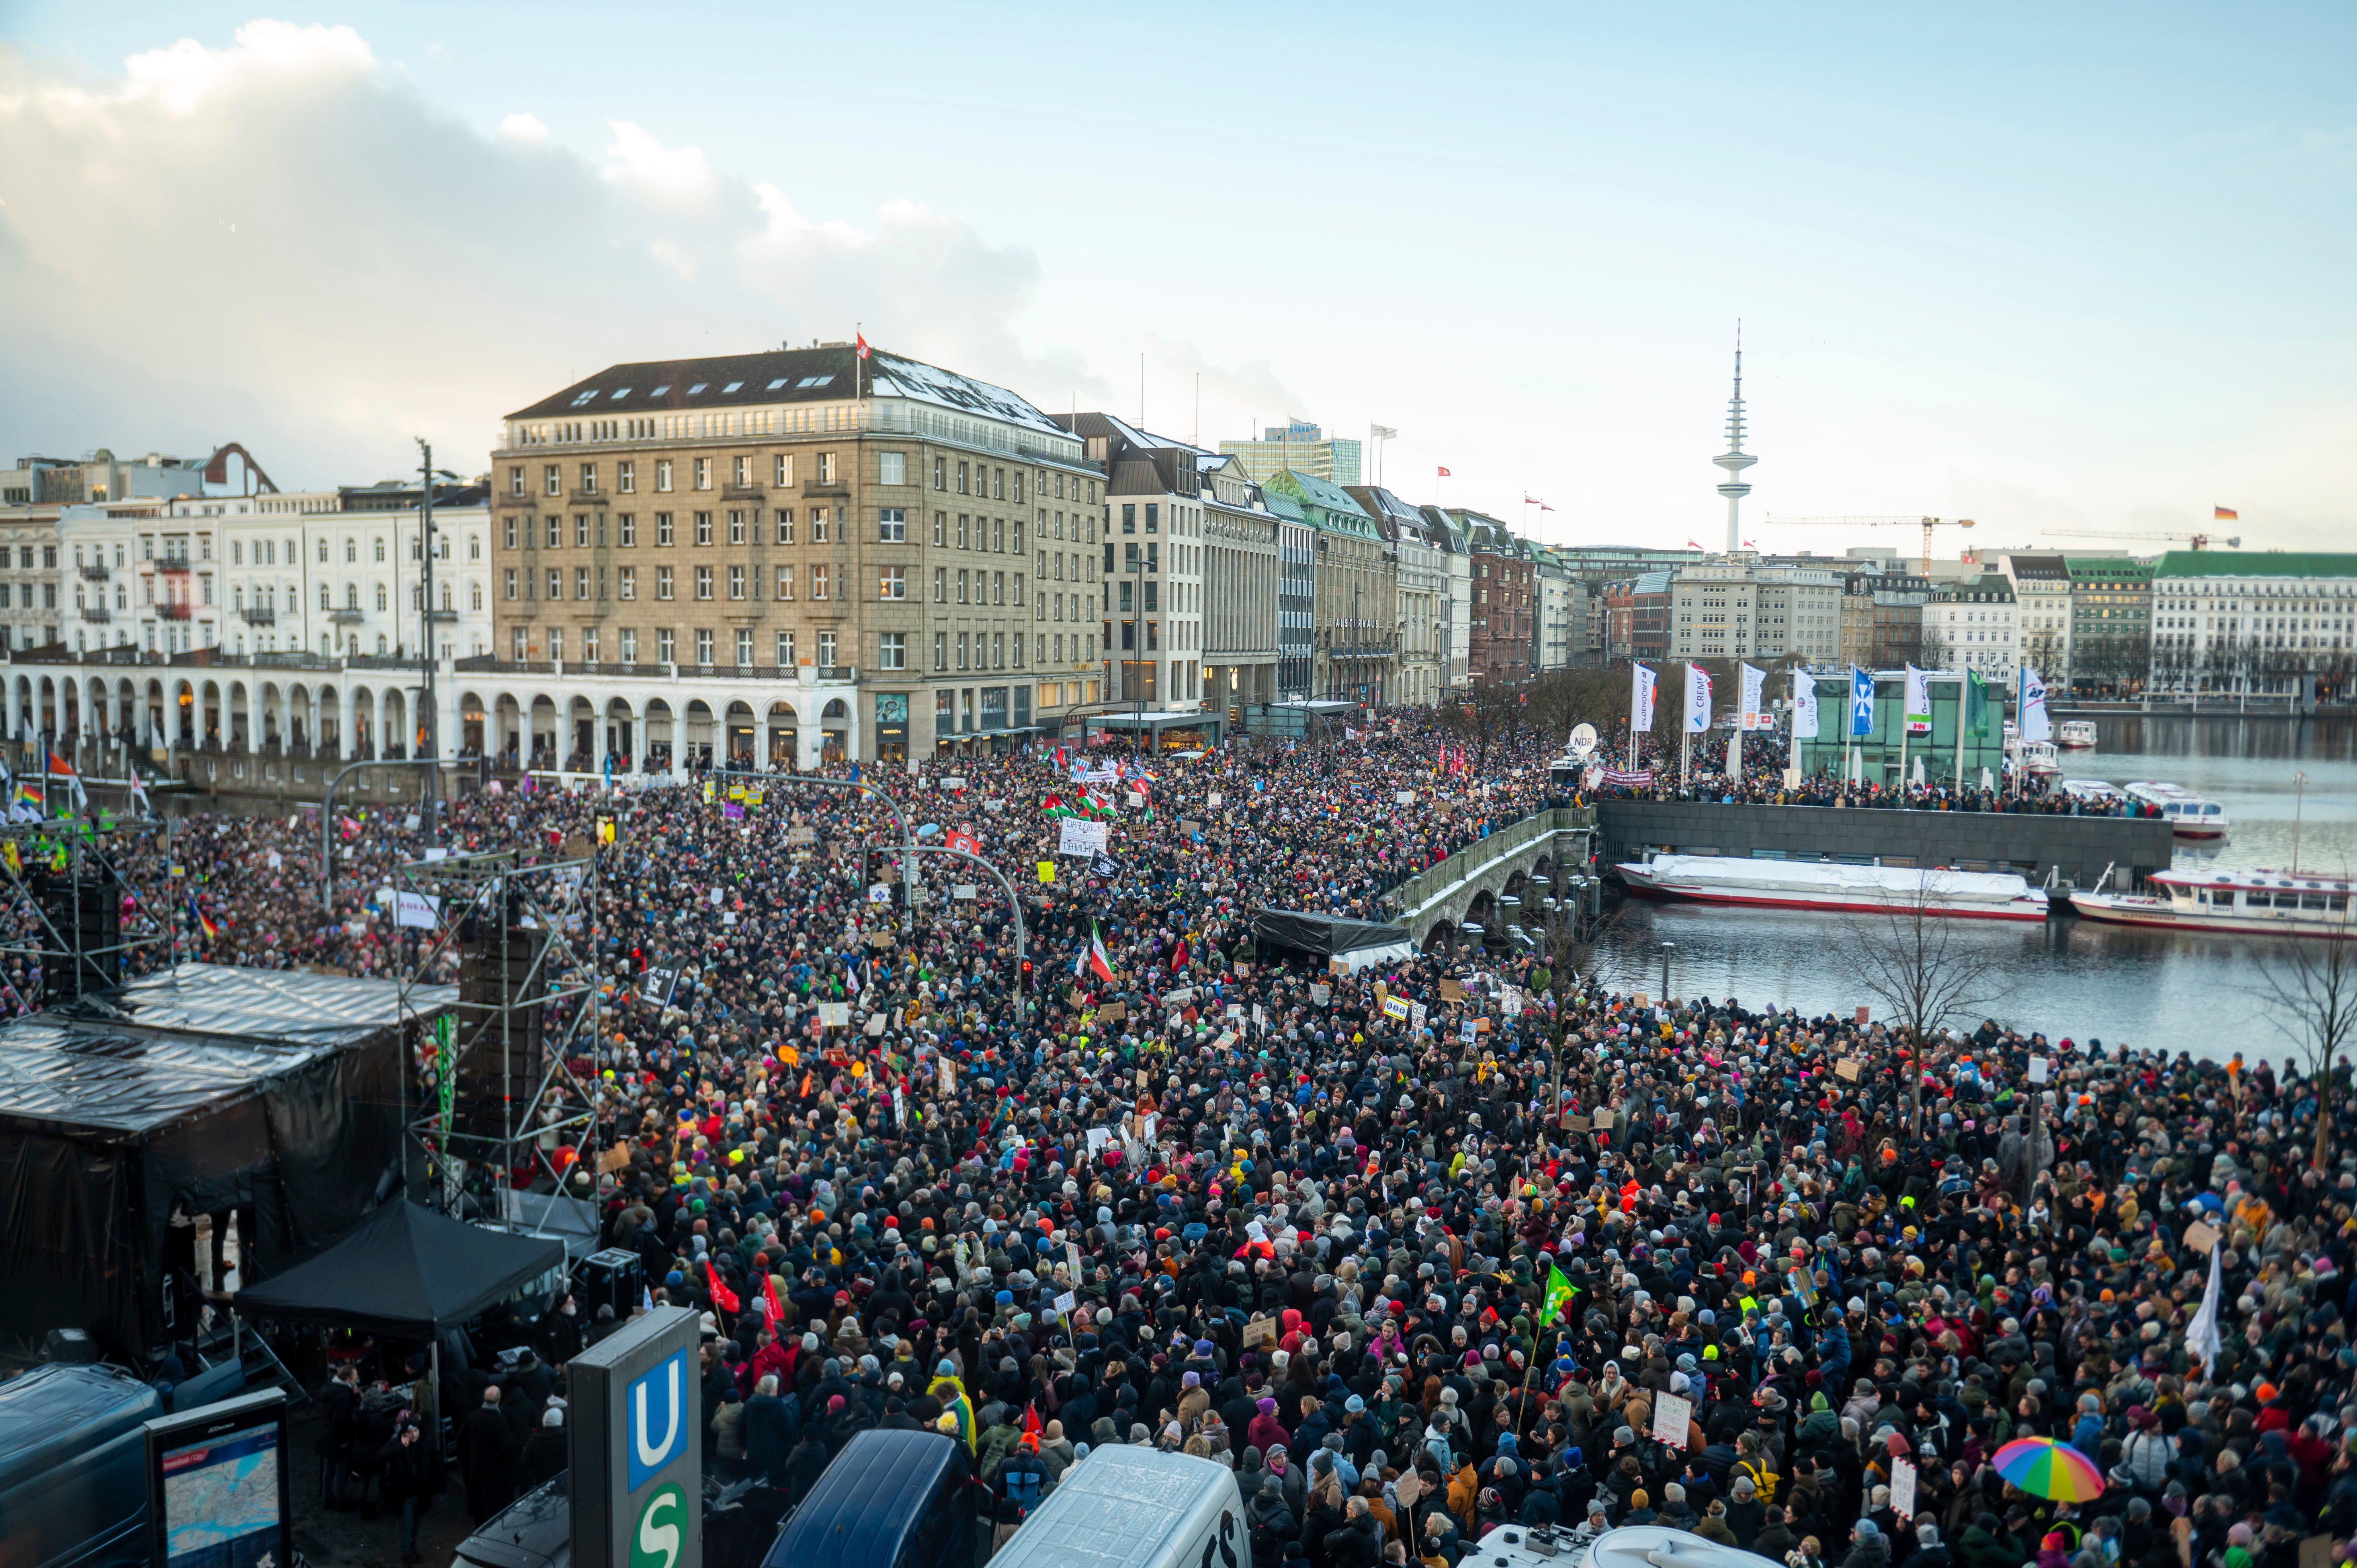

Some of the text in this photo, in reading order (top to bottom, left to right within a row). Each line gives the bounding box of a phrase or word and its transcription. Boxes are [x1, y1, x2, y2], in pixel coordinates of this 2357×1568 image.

[1575, 737, 1592, 746] NDR
[1104, 857, 1120, 868] PAULI
[1413, 1003, 1425, 1016] EKEL
[1658, 1392, 1690, 1411] MENSCHEN
[636, 1359, 679, 1466] U
[1661, 1404, 1682, 1417] RECHTE
[1663, 1413, 1680, 1426] STATT
[1659, 1420, 1682, 1434] RECHTE
[1653, 1428, 1685, 1445] MENSCHEN
[193, 1452, 204, 1461] City
[639, 1492, 679, 1568] S
